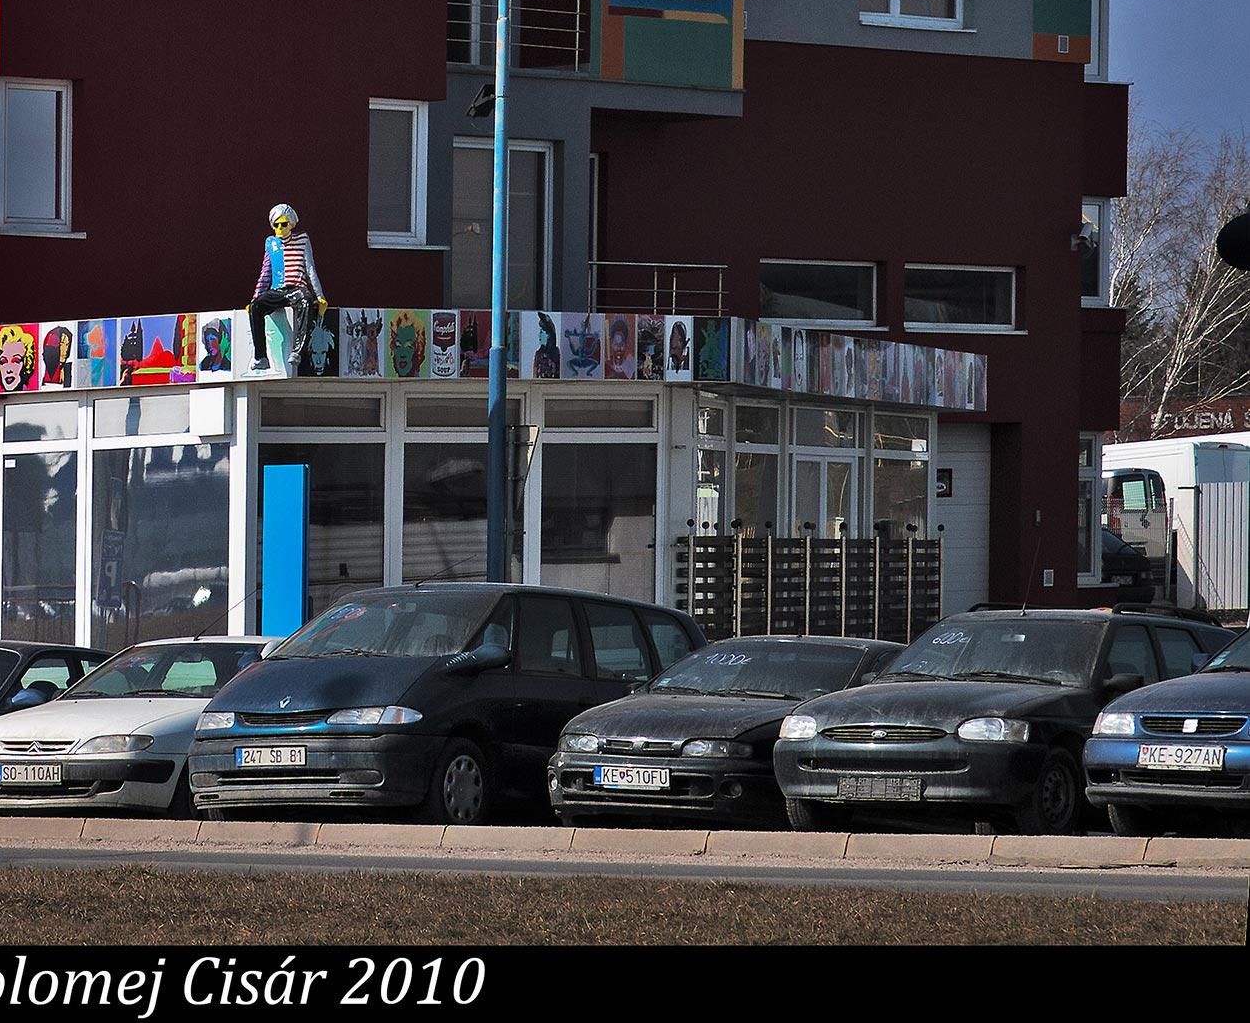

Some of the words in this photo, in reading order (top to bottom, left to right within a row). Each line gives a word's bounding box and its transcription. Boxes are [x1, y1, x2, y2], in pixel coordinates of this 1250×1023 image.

[244, 750, 262, 764] 247
[270, 749, 282, 763] SB
[290, 749, 302, 763] 81
[1149, 747, 1222, 765] KE-927AN
[3, 766, 60, 781] SO-110AH
